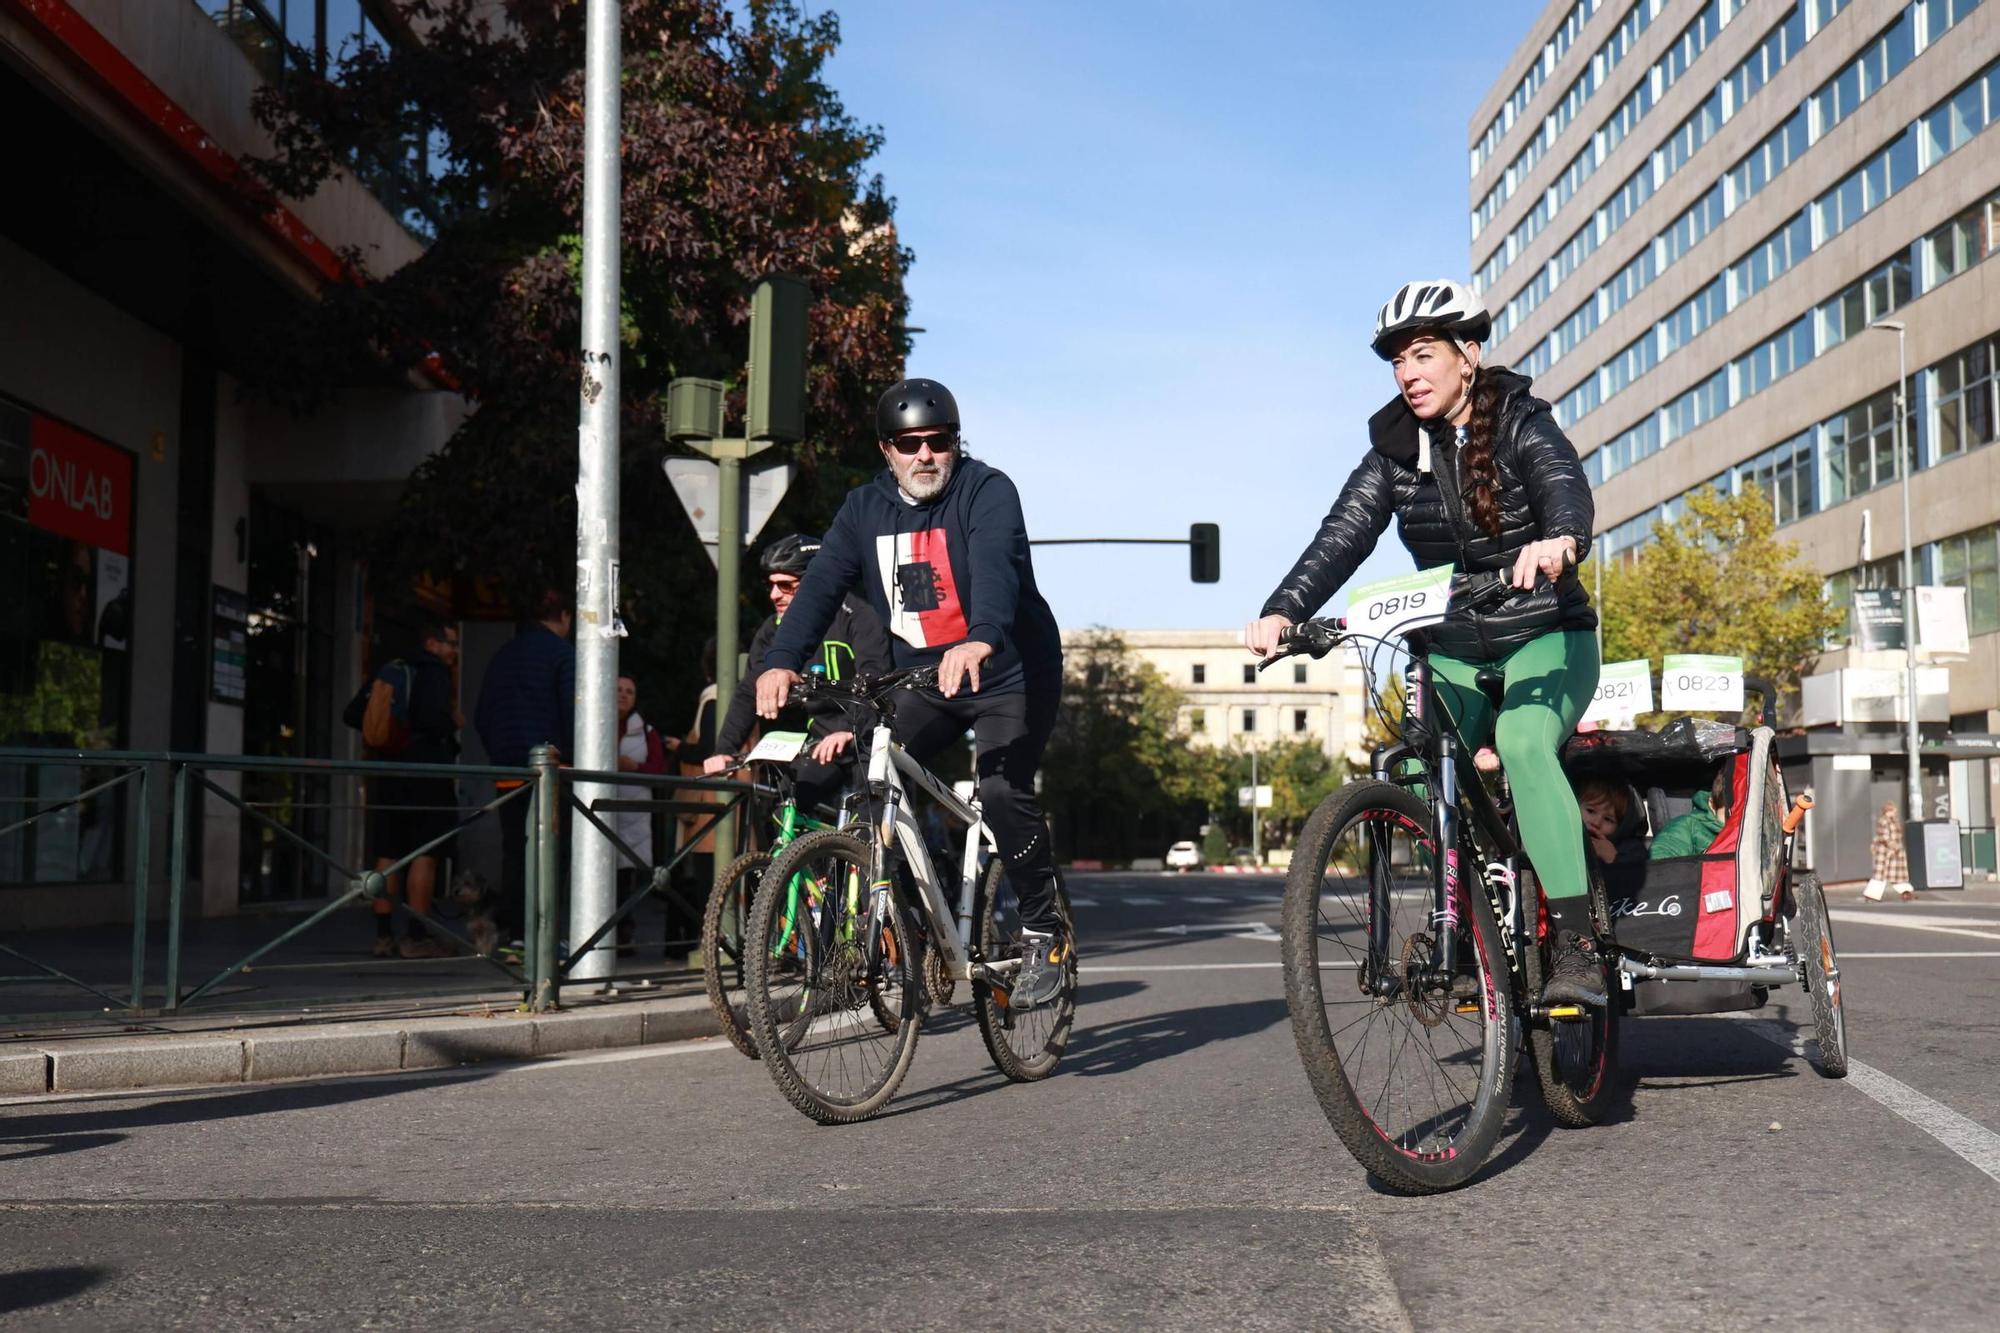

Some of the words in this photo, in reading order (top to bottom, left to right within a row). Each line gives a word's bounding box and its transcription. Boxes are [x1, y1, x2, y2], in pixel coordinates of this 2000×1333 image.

[1368, 592, 1427, 620] 0819
[1678, 675, 1730, 691] 0823
[1495, 991, 1507, 1097] CONTINENTAL
